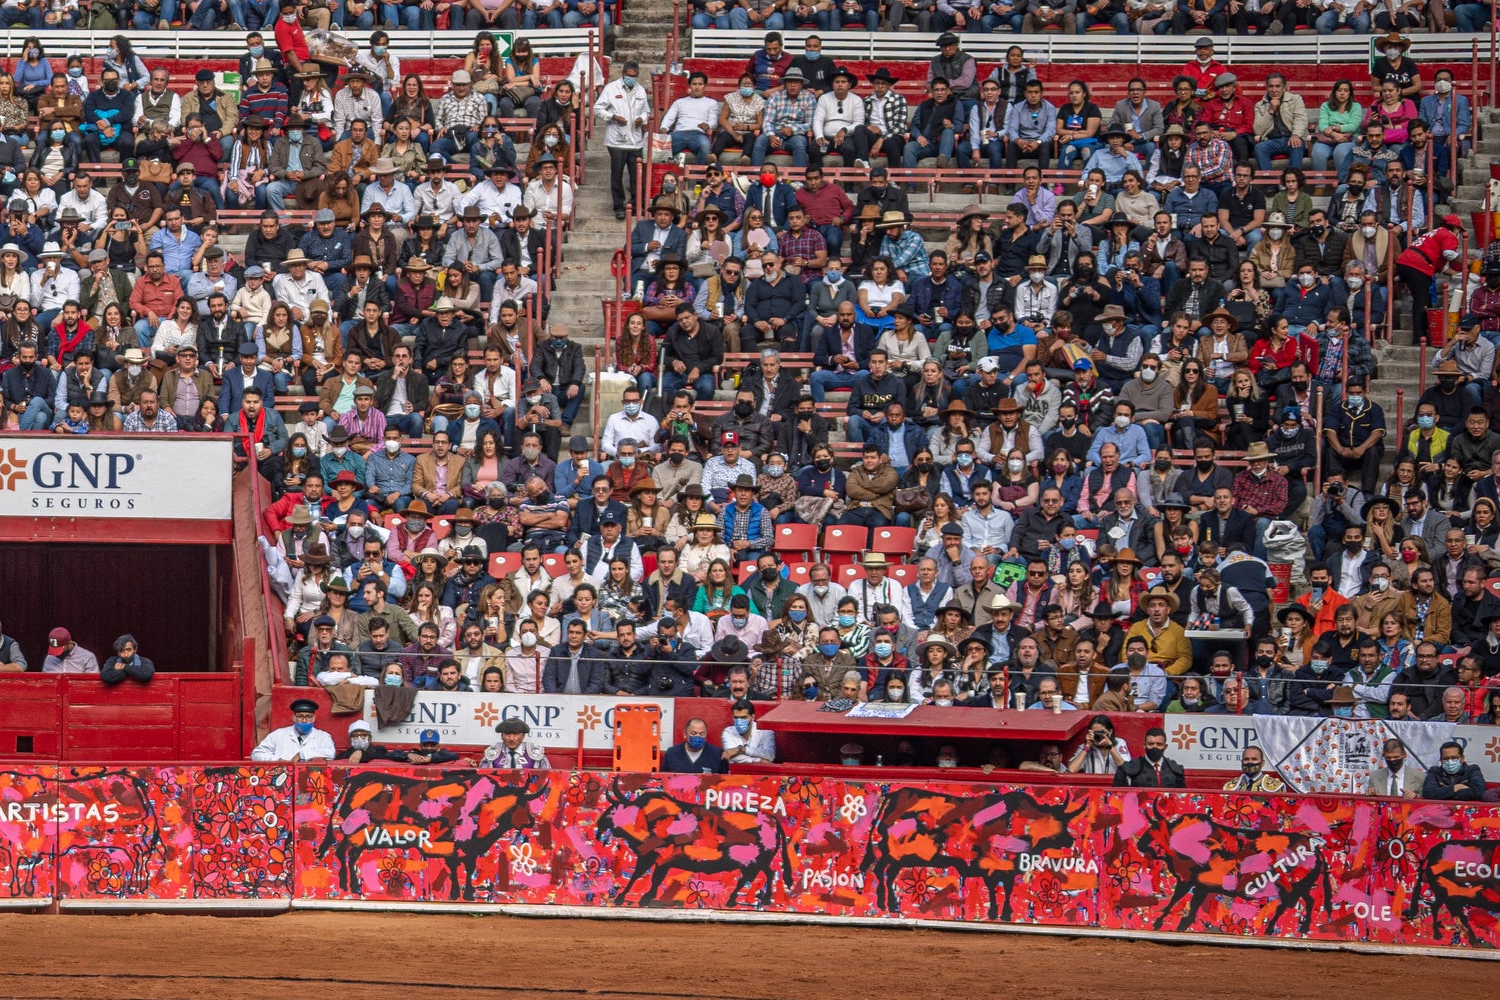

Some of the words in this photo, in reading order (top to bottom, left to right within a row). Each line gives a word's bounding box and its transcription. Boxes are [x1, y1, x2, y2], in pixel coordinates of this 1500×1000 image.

[863, 393, 893, 404] BOSS
[32, 451, 135, 489] GNP
[31, 497, 135, 509] SEGUROS
[1199, 726, 1258, 750] GNP
[1199, 753, 1242, 761] SEGUR
[705, 788, 787, 816] PUREZA
[364, 826, 434, 848] VALOR
[1019, 853, 1100, 874] BRAVURA
[1244, 837, 1327, 896] CULTURA
[803, 866, 865, 889] PASIÓN
[1353, 901, 1392, 921] OLE
